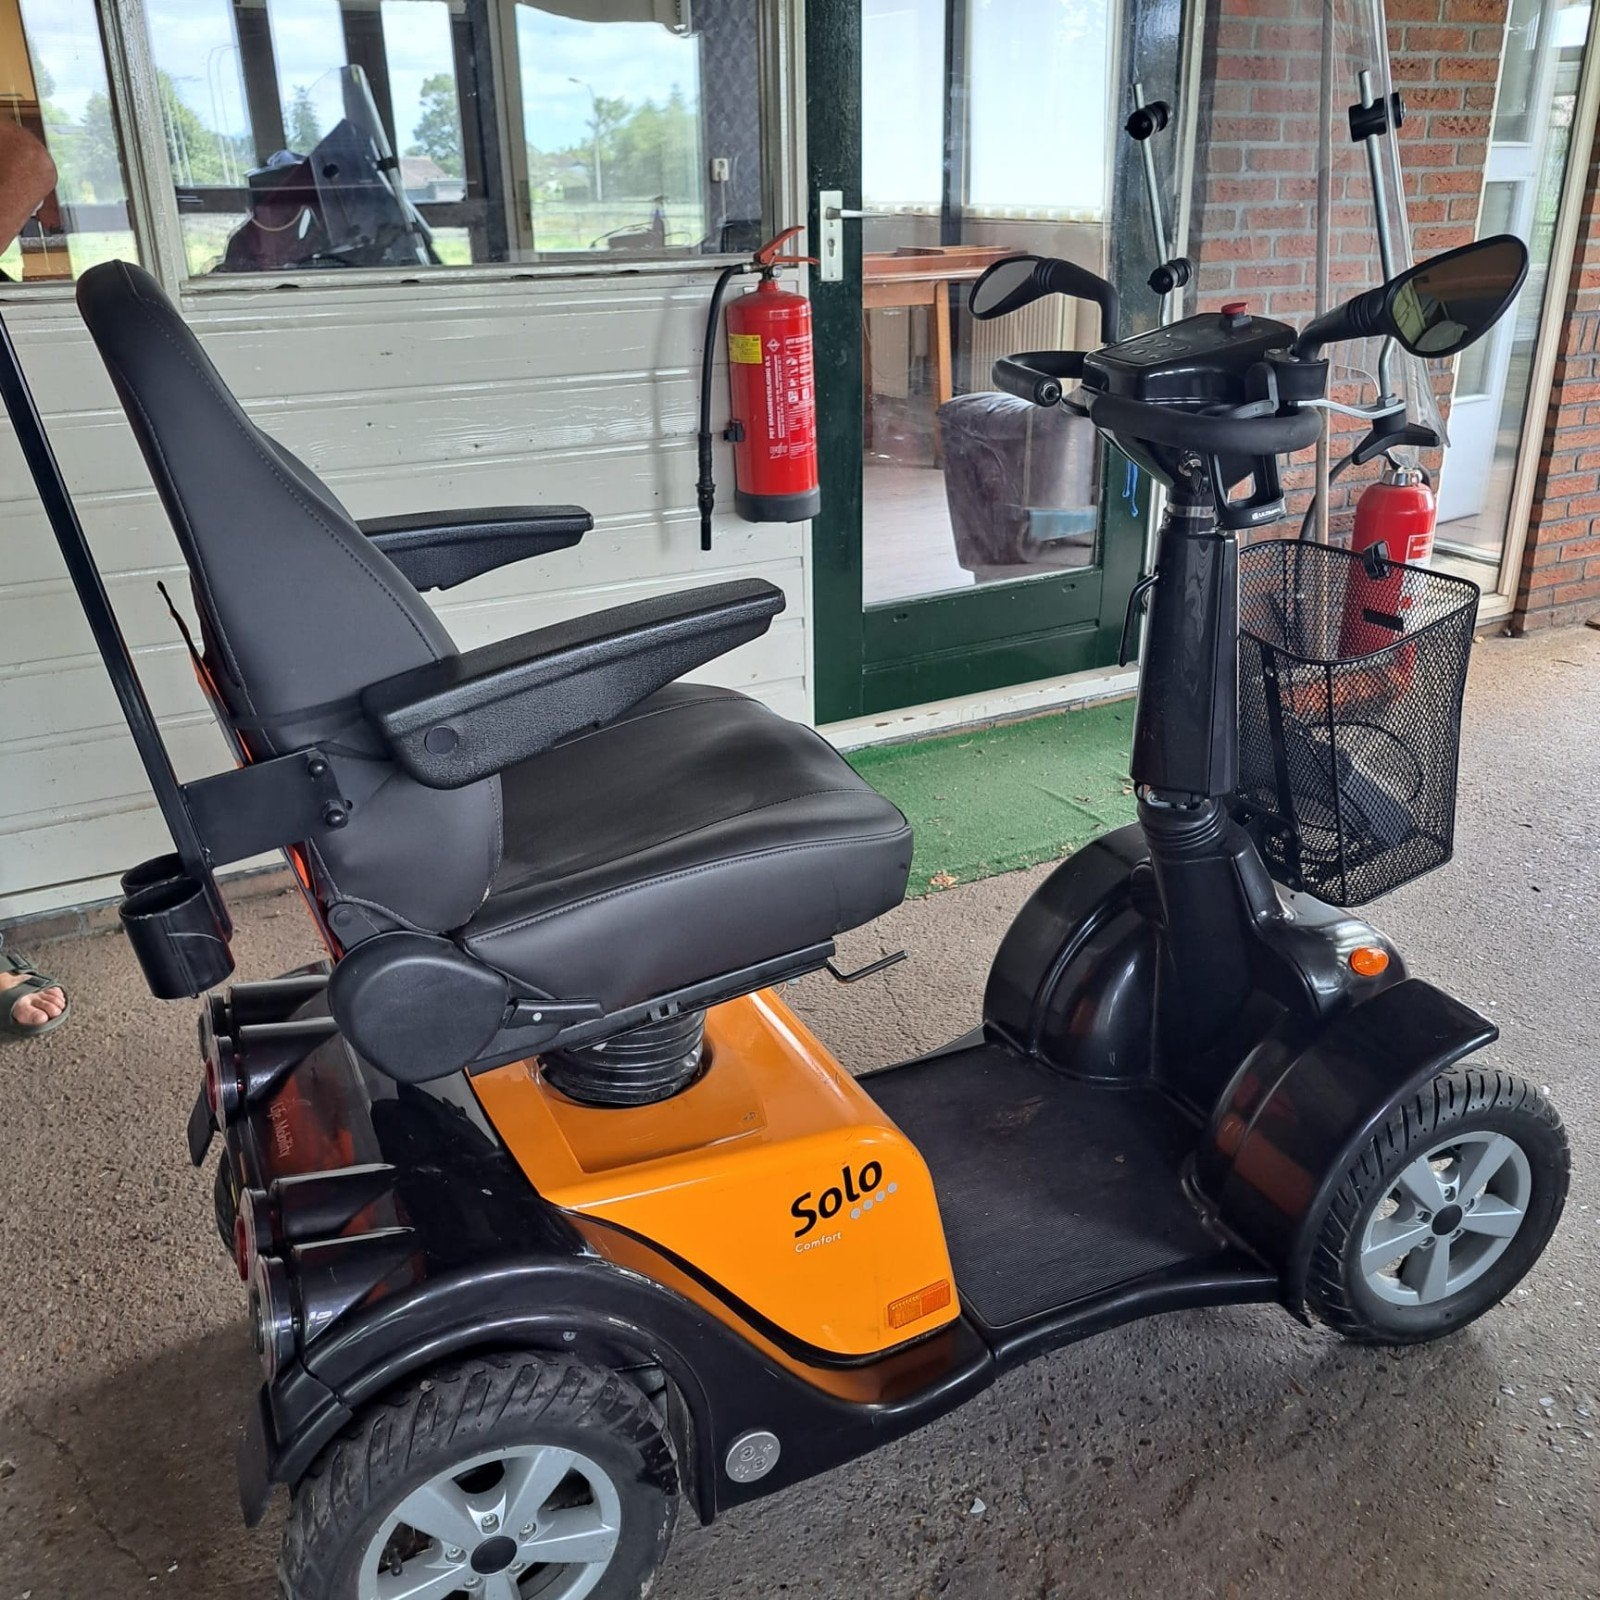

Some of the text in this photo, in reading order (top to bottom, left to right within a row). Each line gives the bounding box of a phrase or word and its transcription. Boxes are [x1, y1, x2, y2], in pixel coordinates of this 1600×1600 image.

[274, 1119, 293, 1158] Mobility
[791, 1160, 883, 1239] Solo
[795, 1232, 842, 1253] Comfort
